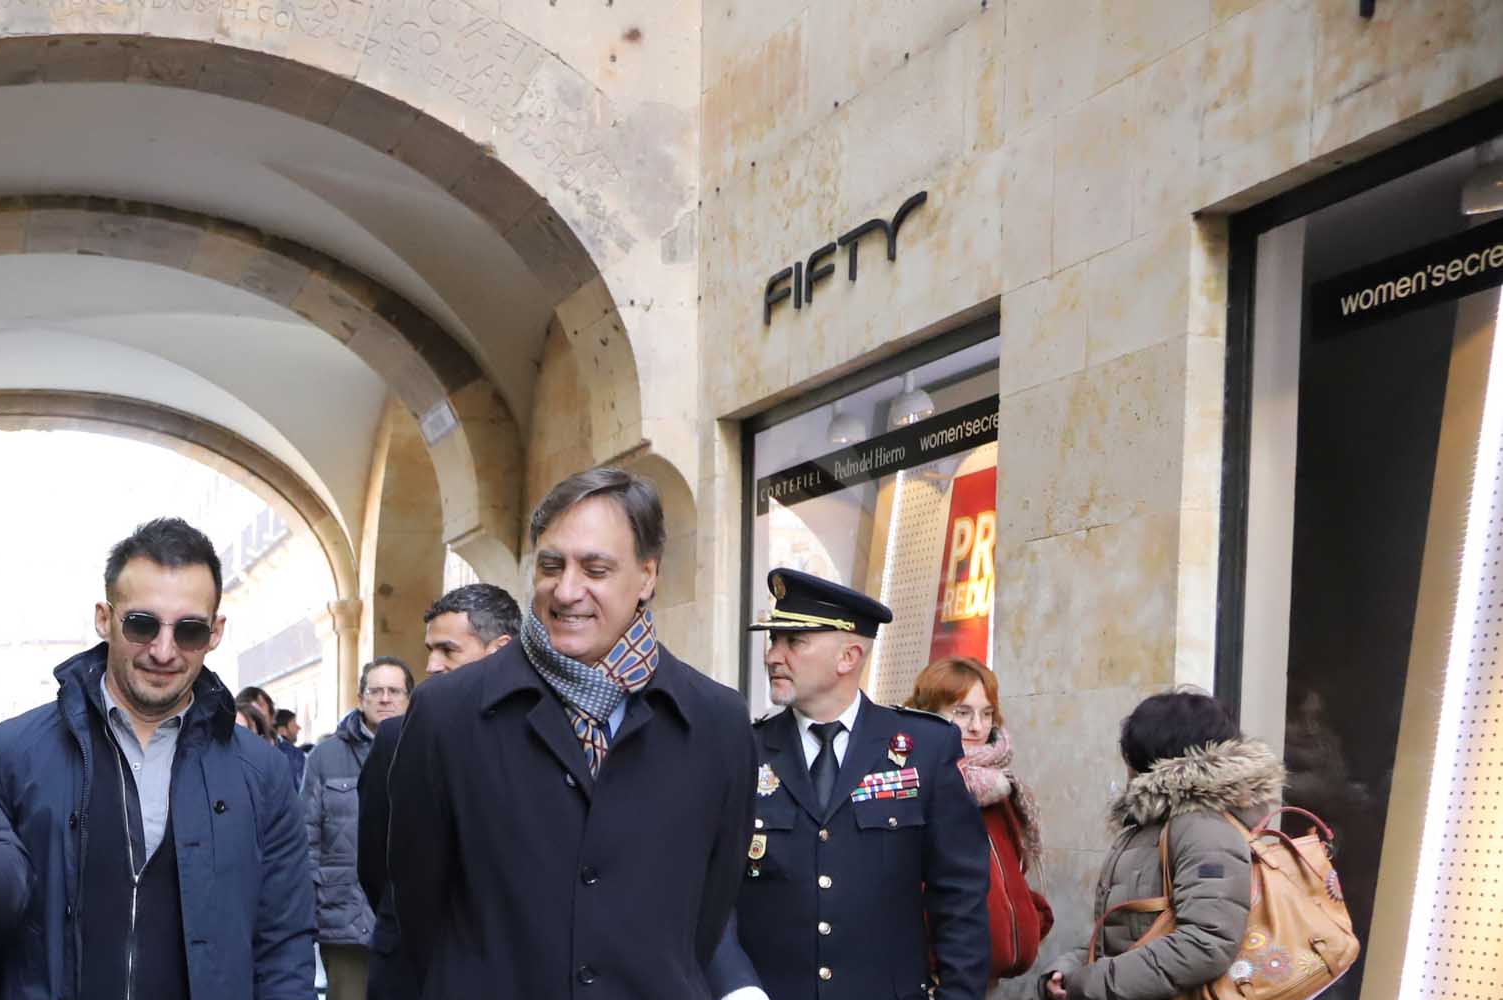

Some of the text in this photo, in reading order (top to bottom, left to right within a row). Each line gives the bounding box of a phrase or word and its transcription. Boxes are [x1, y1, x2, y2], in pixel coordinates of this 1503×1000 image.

[763, 190, 928, 326] FIFTY
[760, 471, 822, 502] CORTEFIEL
[834, 458, 860, 481] Pedro
[859, 451, 873, 473] del
[874, 445, 906, 468] Hierro
